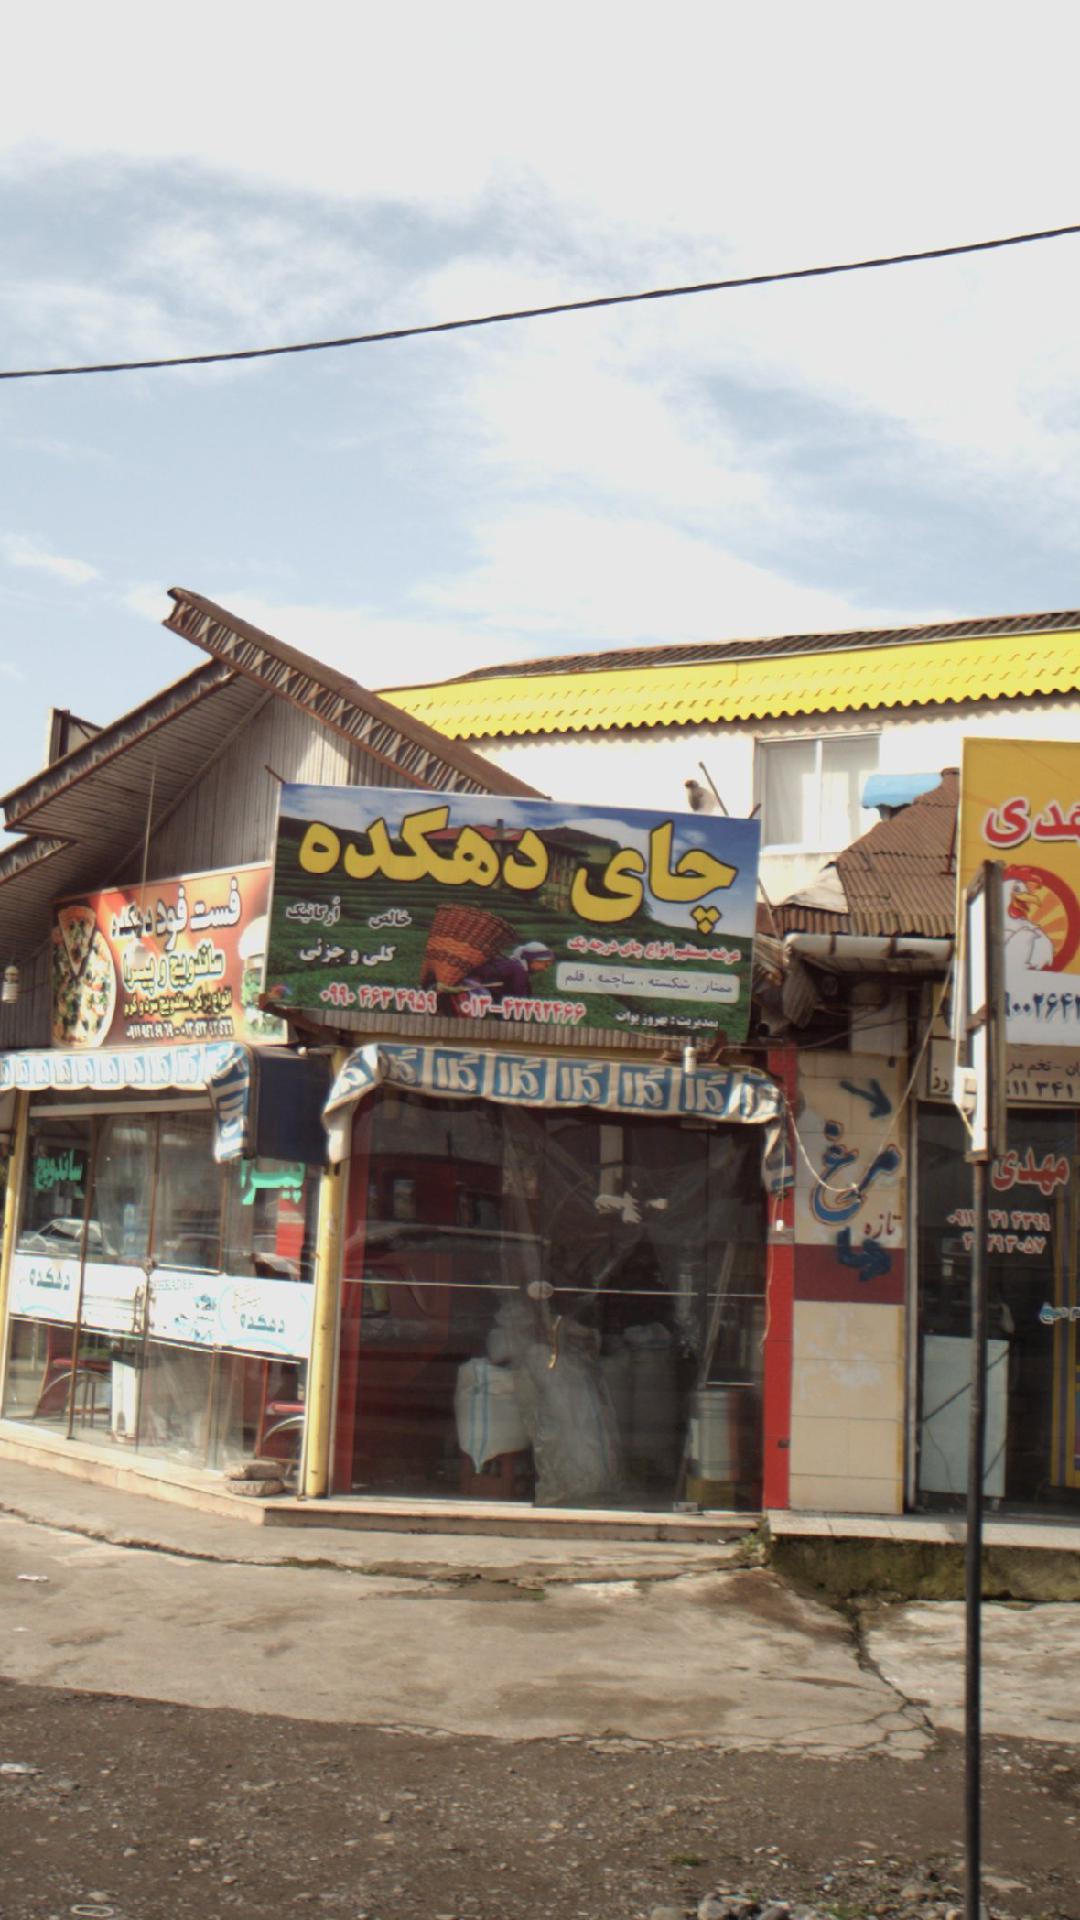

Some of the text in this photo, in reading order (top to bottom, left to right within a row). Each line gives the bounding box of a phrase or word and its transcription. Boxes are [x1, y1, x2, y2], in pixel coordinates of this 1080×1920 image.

[299, 805, 738, 935] چای دهکده
[156, 884, 188, 951] فود
[190, 876, 241, 931] فست
[368, 908, 413, 930] خالص
[349, 949, 360, 966] و
[362, 945, 397, 967] کلی
[566, 935, 742, 965] عرضه مستقیم انواع چای درجه یک
[564, 969, 733, 994] ممتاز شکسته ساچمه قلم
[991, 1147, 1070, 1196] مهدی
[864, 1211, 902, 1239] تازه
